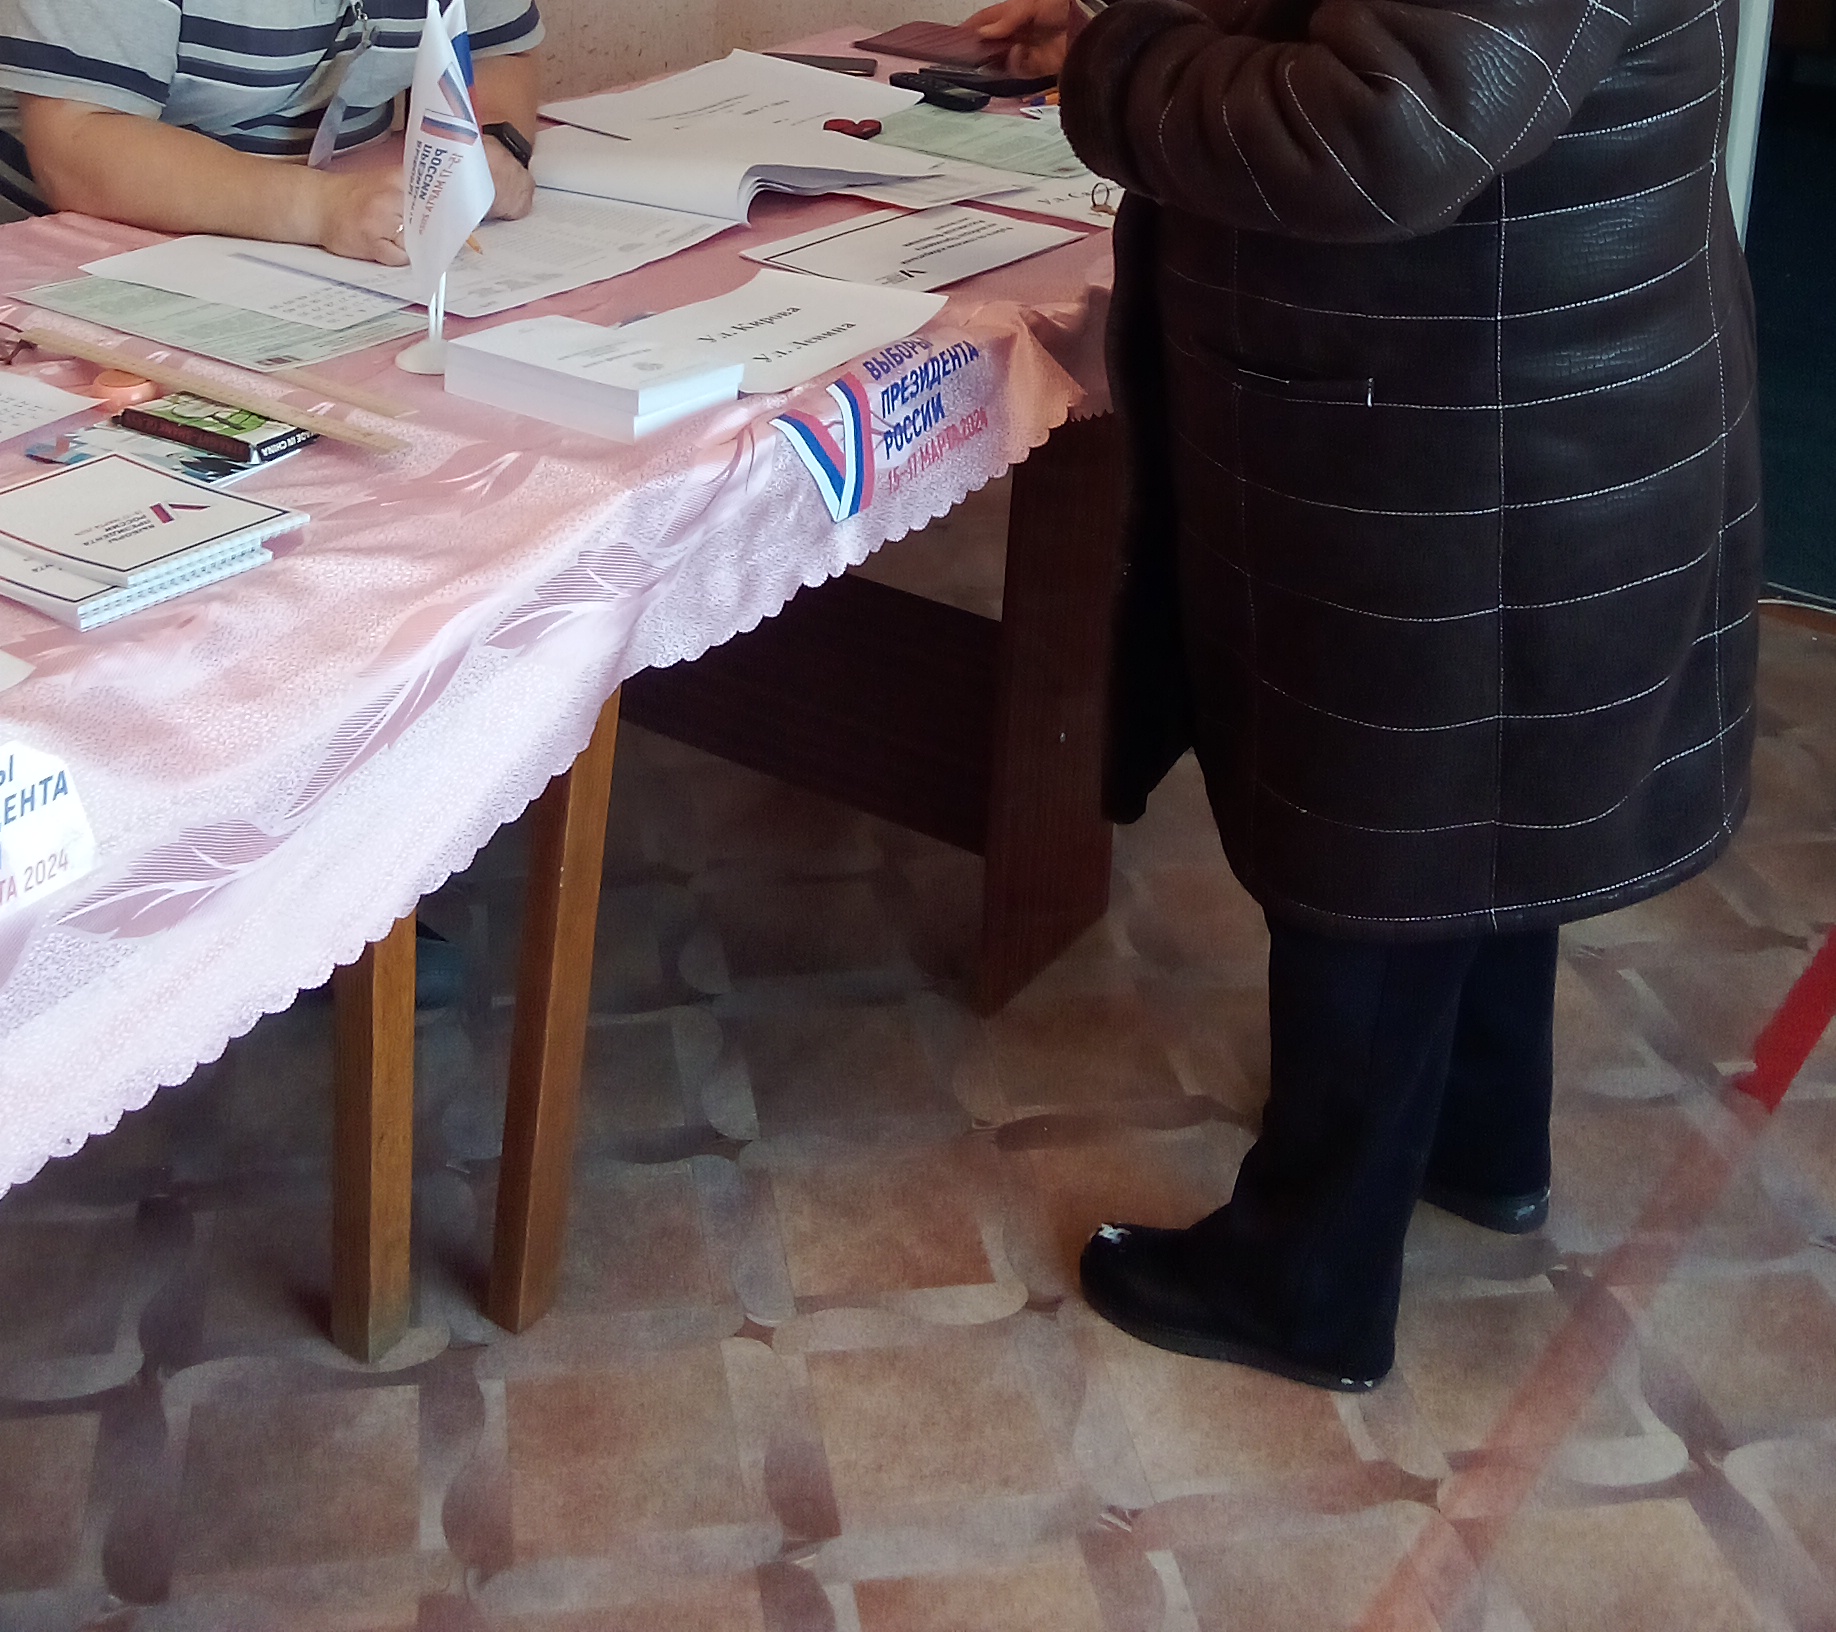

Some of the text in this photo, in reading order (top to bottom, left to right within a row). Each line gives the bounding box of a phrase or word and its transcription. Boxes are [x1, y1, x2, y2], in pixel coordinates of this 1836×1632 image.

[731, 307, 801, 332] Кирова
[790, 322, 857, 349] Ленина
[863, 337, 934, 381] ВЫБОРЫ
[880, 340, 980, 419] ПРЕЗИДЕНТА
[884, 391, 946, 461] РОССИИ
[919, 424, 962, 472] МАРТА
[960, 406, 988, 441] 2024
[105, 514, 147, 532] РОССИИ
[0, 770, 69, 829] ЕНТА
[24, 848, 69, 892] 2024
